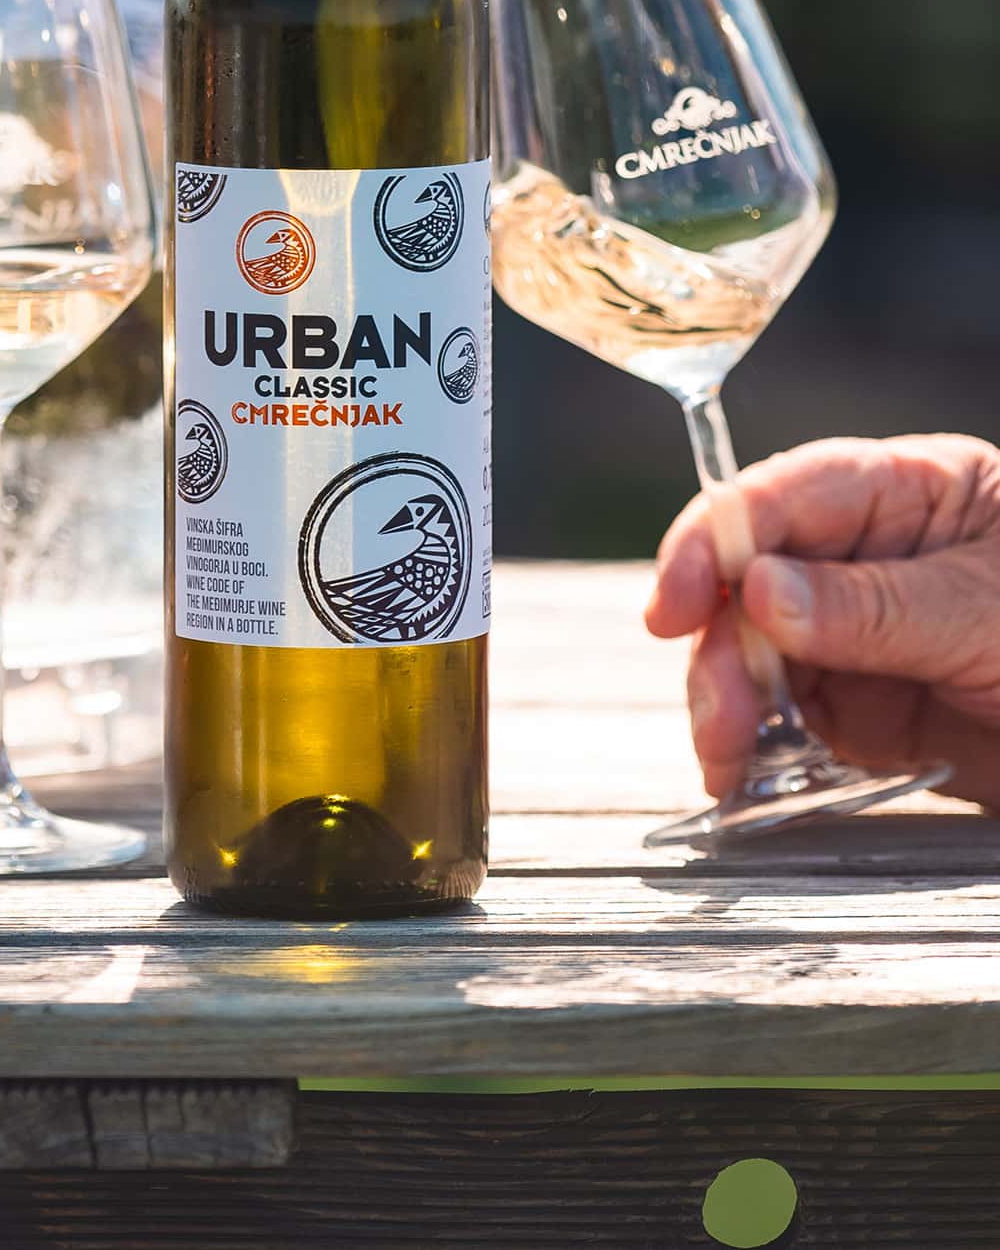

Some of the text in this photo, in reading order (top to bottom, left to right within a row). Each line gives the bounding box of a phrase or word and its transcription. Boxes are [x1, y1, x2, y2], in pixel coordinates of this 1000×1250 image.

[204, 309, 432, 370] URBAN
[254, 375, 378, 398] CLASSIC
[231, 400, 404, 428] CMREČNJAK
[186, 517, 243, 537] VINSKA ŠIFRA
[186, 555, 269, 577] VINOGORJA U BOCI.
[186, 574, 245, 595] WINE CODE OF
[186, 593, 200, 609] THE
[258, 600, 286, 616] WINE
[186, 612, 279, 635] REGION IN A BOTTLE.
